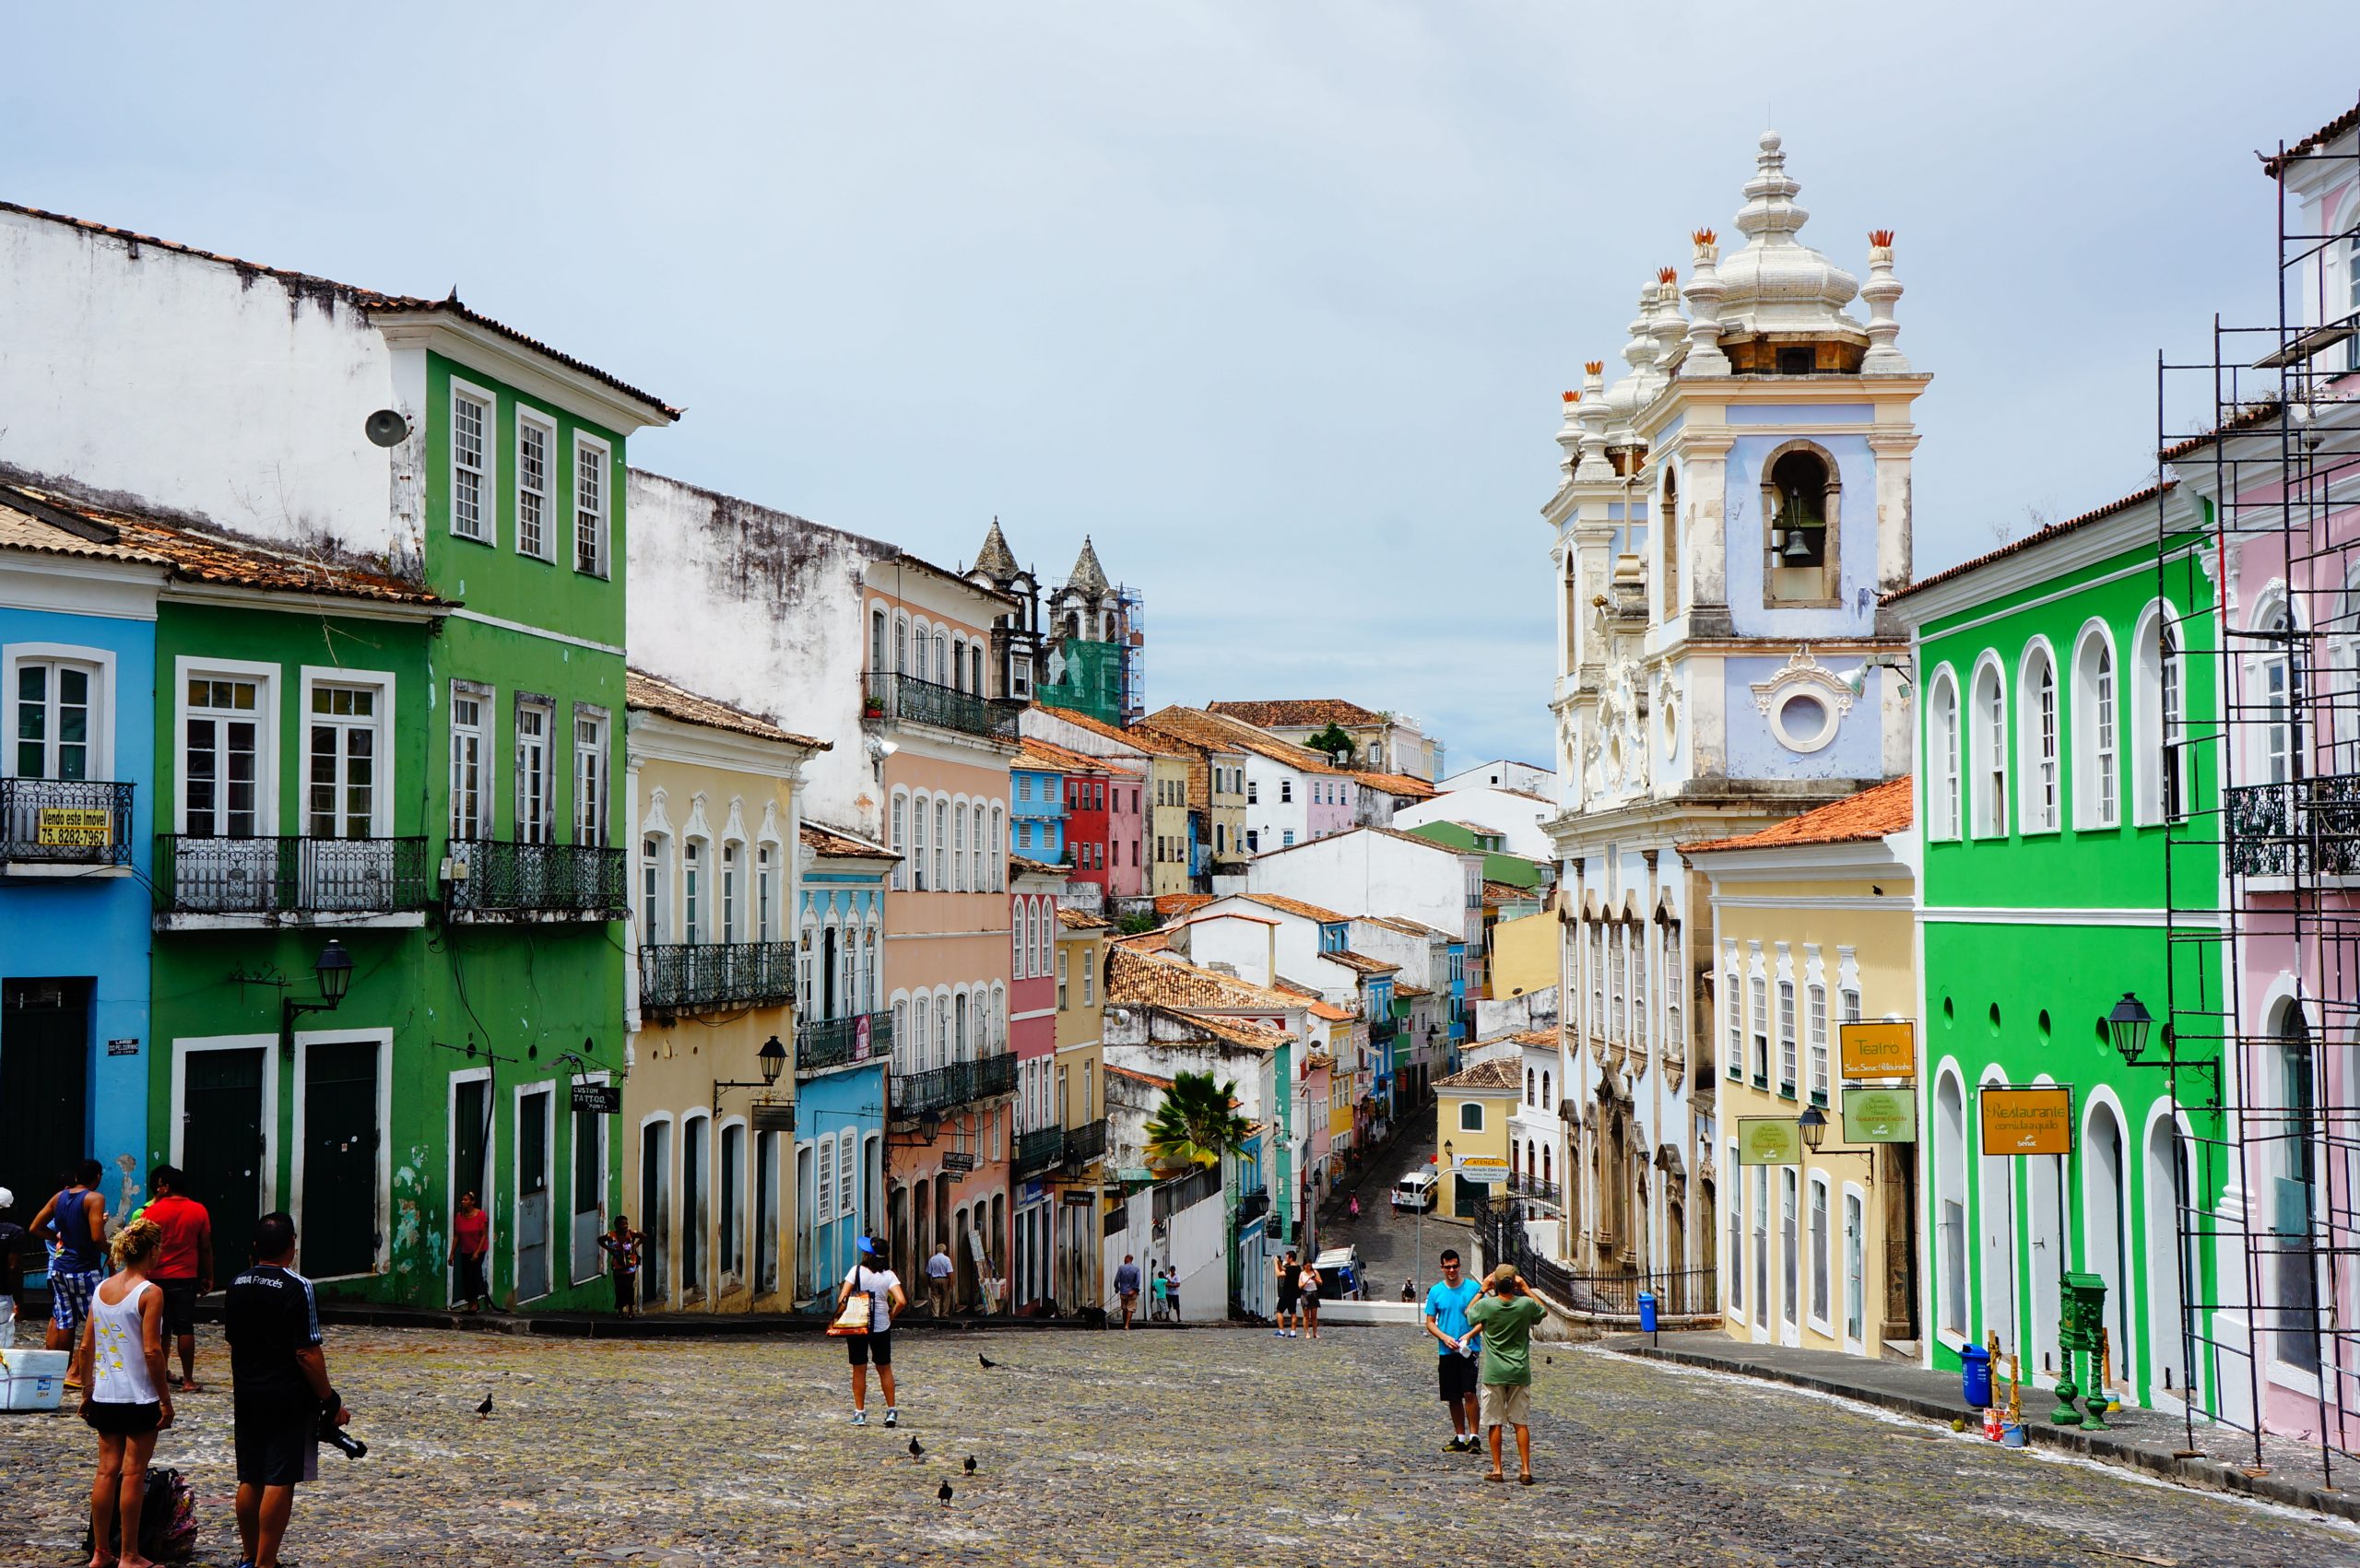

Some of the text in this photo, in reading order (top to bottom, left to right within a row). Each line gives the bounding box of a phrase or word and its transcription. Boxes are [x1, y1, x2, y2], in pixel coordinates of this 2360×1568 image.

[42, 810, 106, 827] Vendo este Imóvel
[58, 829, 105, 845] 8282-7962
[1854, 1039, 1900, 1055] Teatro
[573, 1094, 605, 1103] TATTOO
[1986, 1102, 2066, 1118] Restaurante
[957, 1154, 973, 1163] ARTES
[234, 1275, 284, 1289] BBVA Francés
